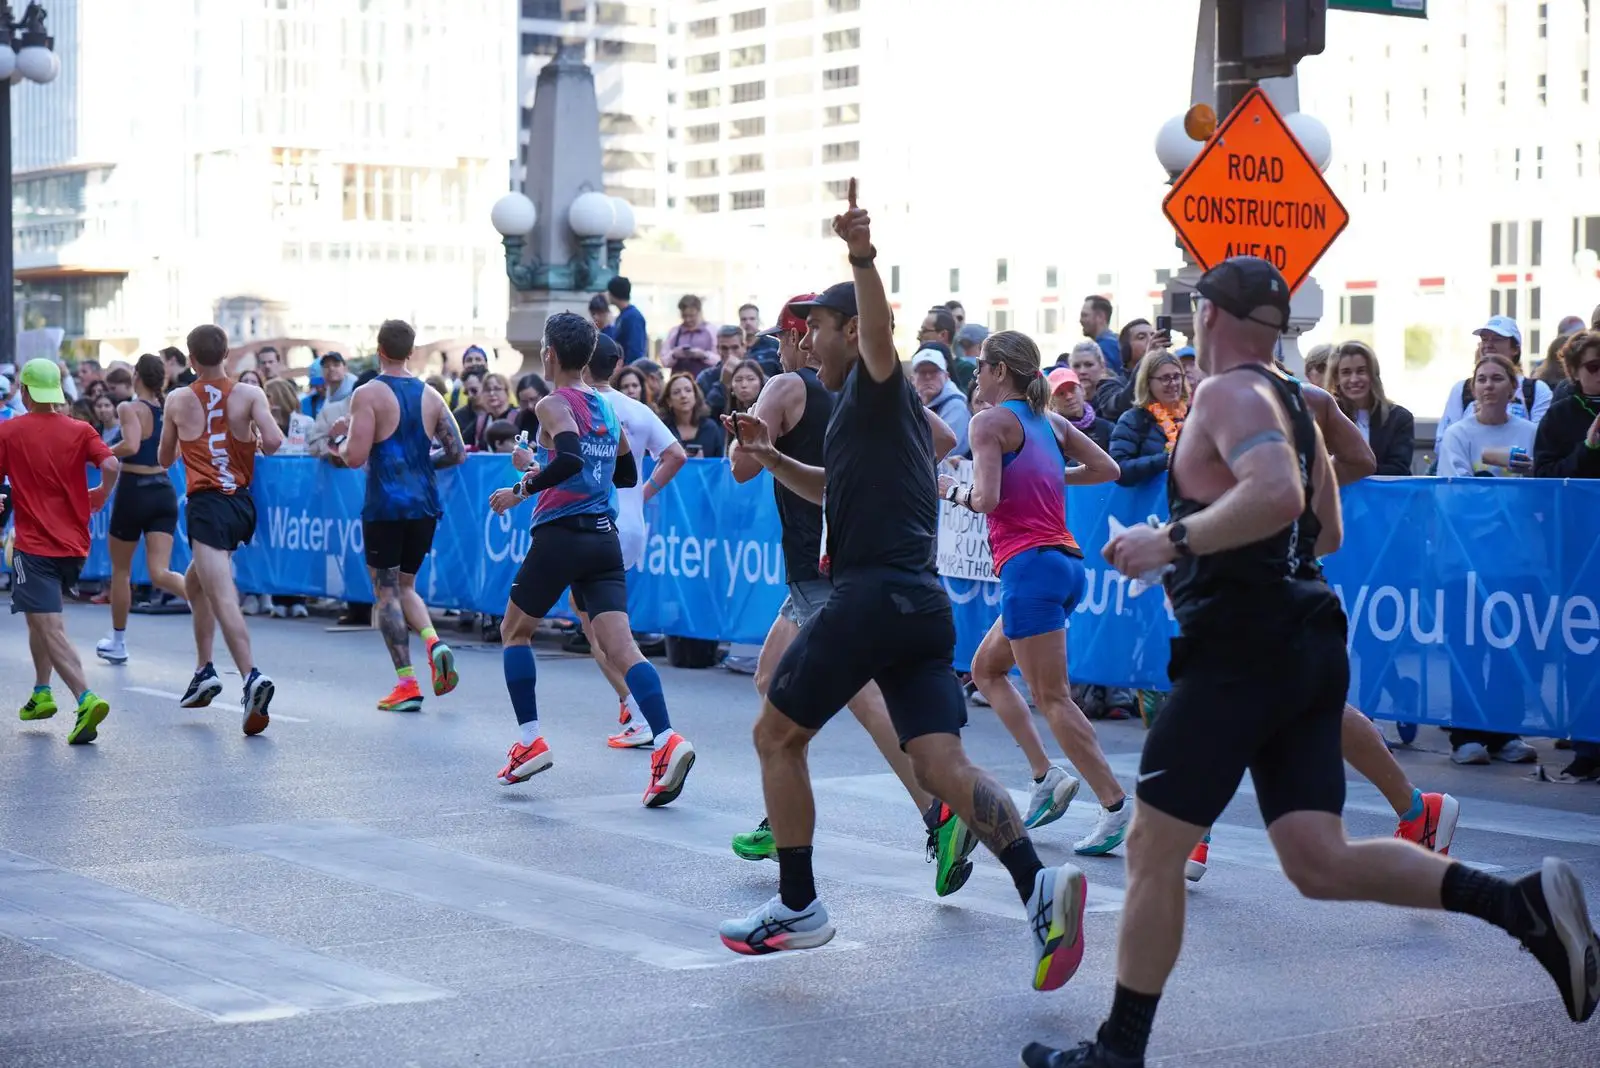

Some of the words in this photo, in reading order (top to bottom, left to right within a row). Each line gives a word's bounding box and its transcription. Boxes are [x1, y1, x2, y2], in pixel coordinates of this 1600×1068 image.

[1228, 153, 1284, 183] ROAD
[1184, 194, 1326, 230] CONSTRUCTION
[580, 441, 617, 457] TAIWAN
[267, 506, 333, 552] Water
[635, 522, 717, 578] ater
[723, 539, 782, 597] you
[938, 553, 994, 578] MARATHO
[1334, 583, 1444, 657] you
[1465, 571, 1600, 655] love
